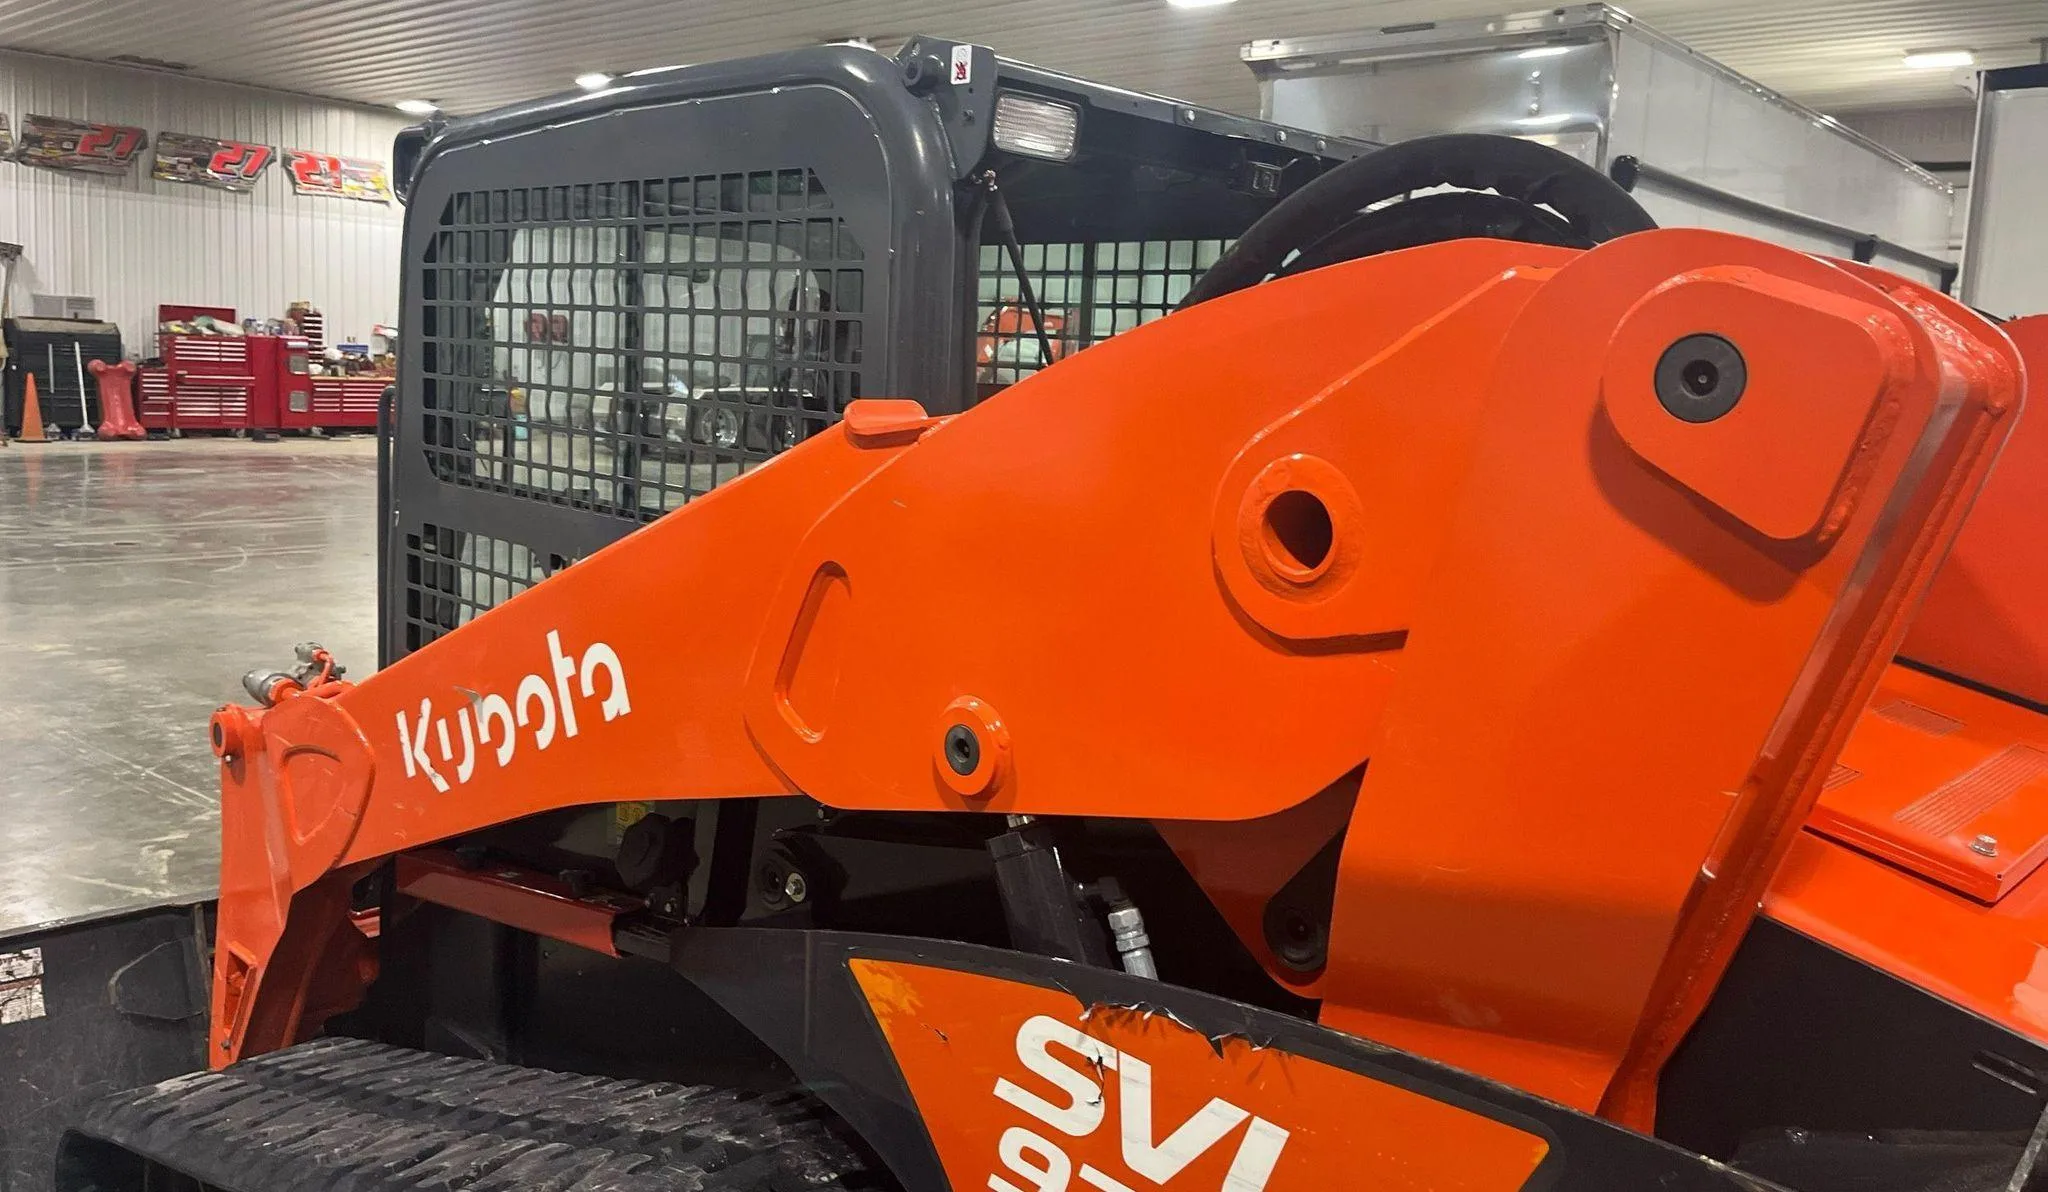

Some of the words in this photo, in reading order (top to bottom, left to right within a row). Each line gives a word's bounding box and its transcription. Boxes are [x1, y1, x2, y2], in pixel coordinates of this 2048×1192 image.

[77, 123, 144, 158] 27
[209, 139, 272, 178] 27
[397, 629, 632, 793] Kubota
[987, 1126, 1136, 1192] 9
